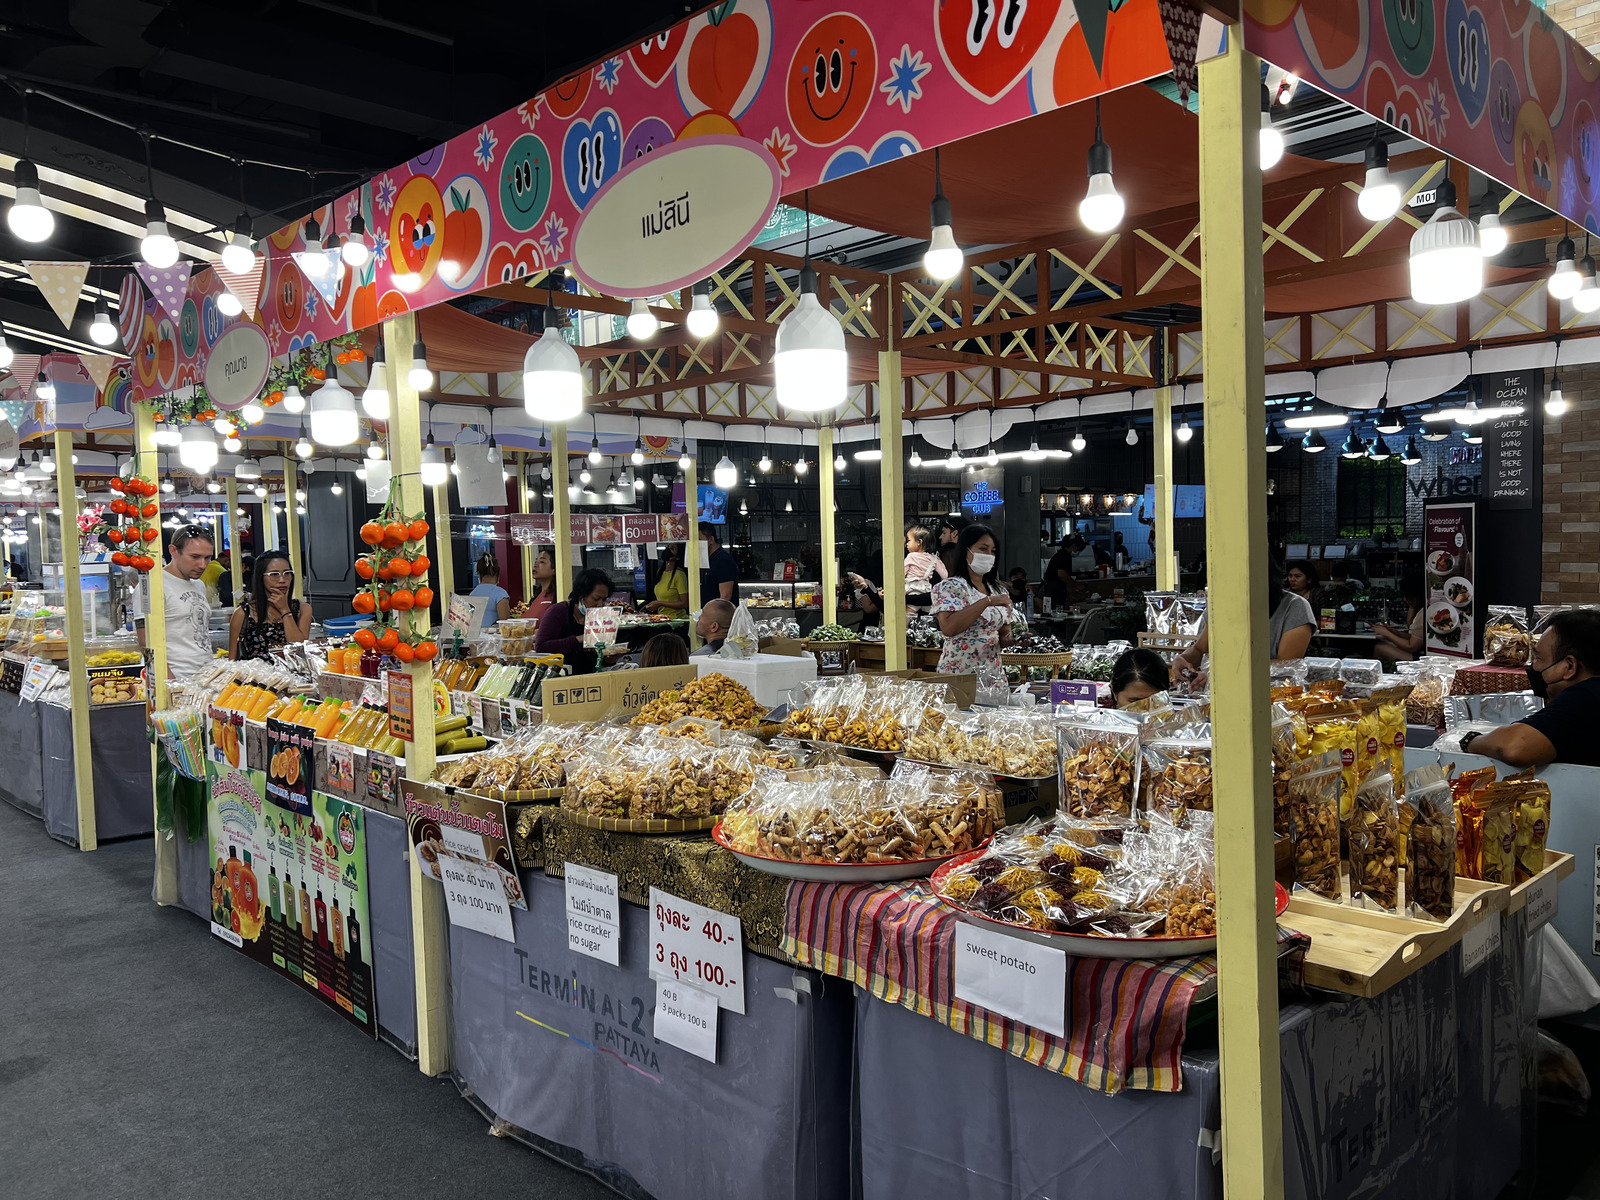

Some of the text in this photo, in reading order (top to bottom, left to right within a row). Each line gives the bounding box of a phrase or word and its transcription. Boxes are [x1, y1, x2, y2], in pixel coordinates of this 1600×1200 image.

[641, 190, 690, 239] แม่สินี
[1504, 376, 1521, 387] THE
[1496, 386, 1527, 398] OCEAN
[1501, 430, 1522, 438] GOOD
[1500, 459, 1522, 468] THERE
[1507, 468, 1523, 477] NOT
[963, 489, 999, 502] COFFEE
[972, 503, 991, 514] CLUB
[625, 527, 641, 539] 60
[457, 844, 480, 856] cracker
[466, 874, 477, 885] 40
[478, 878, 497, 892] บาท
[450, 890, 456, 902] 3
[469, 897, 484, 910] 100
[485, 901, 503, 915] บาท
[569, 917, 612, 939] rice cracker
[656, 903, 735, 945] ถุงละ 40.-
[569, 934, 601, 952] no sugar
[656, 943, 737, 988] 3 ถุง 100.-
[966, 942, 1037, 975] sweet potato
[662, 988, 678, 1001] 40 B
[662, 1002, 707, 1029] 3 packs 100 B
[594, 1021, 661, 1074] PATTAYA
